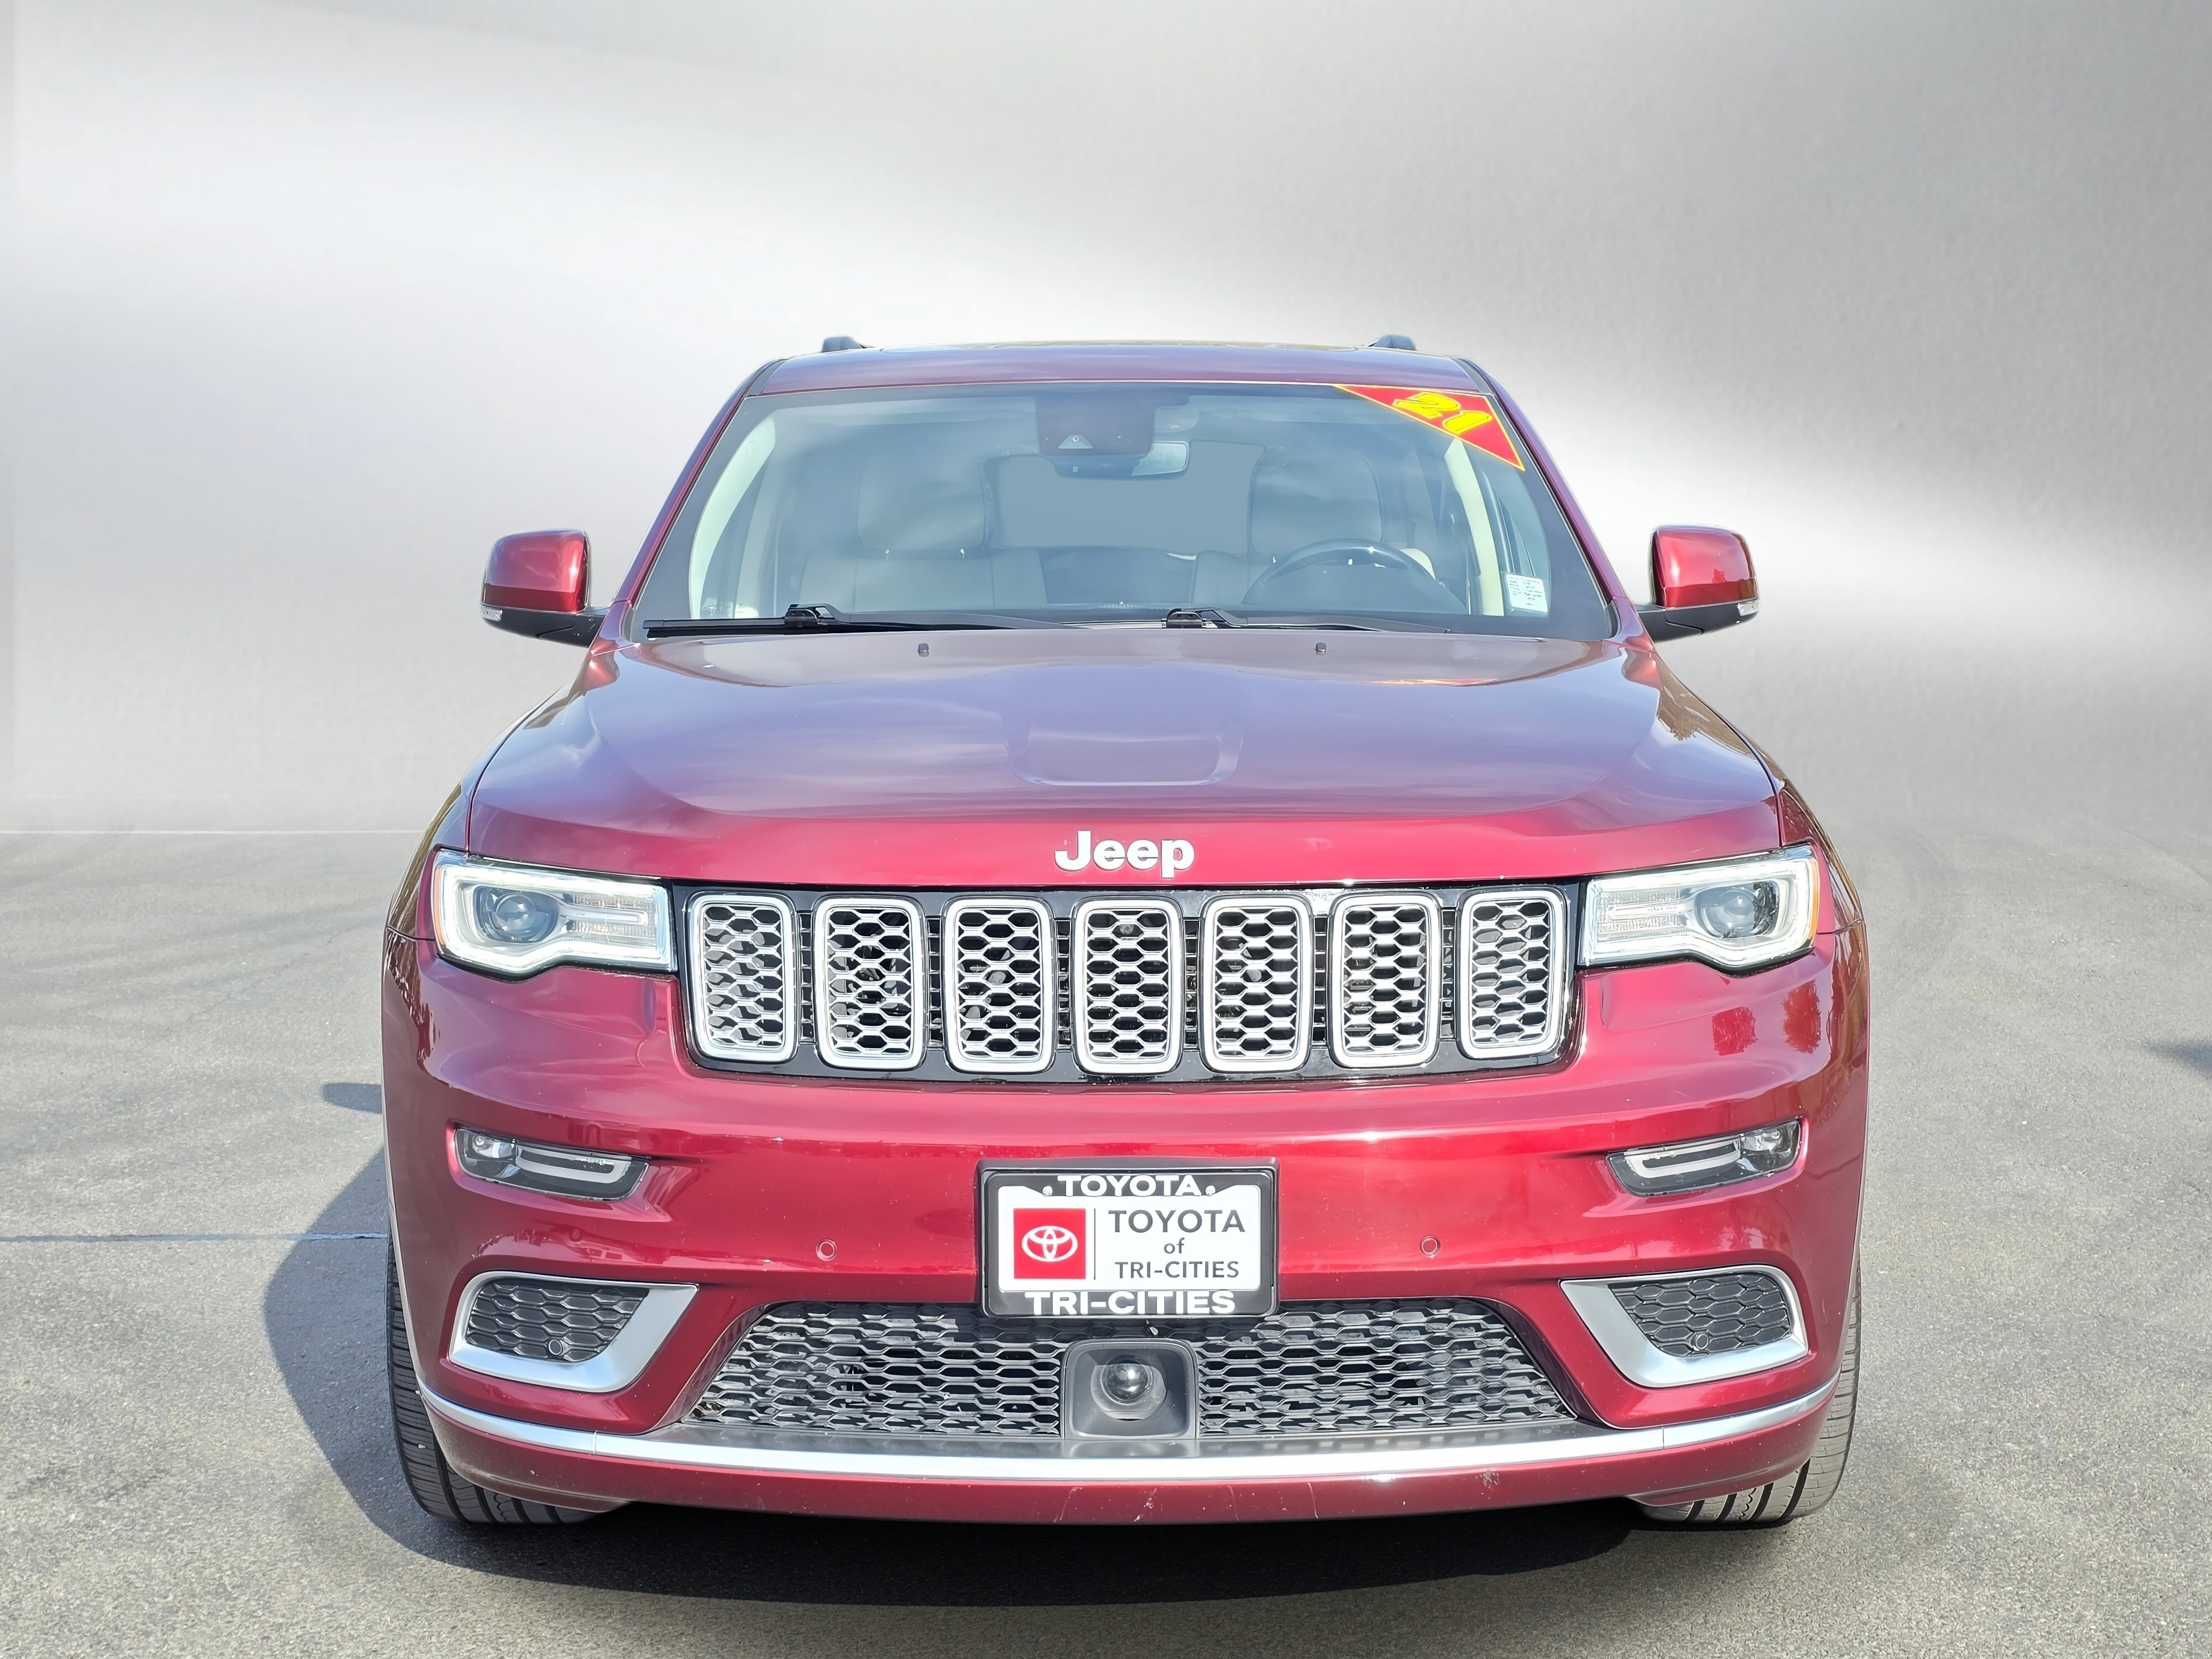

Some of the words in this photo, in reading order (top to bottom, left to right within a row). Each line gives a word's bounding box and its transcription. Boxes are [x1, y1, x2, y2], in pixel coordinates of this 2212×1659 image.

[1392, 391, 1493, 435] 21
[1054, 830, 1194, 879] Jeep
[1057, 1174, 1202, 1197] TOYOTA
[1108, 1209, 1246, 1233] TOYOTA
[1163, 1237, 1185, 1254] of
[1114, 1260, 1239, 1279] TRI-CITIES
[1024, 1290, 1235, 1315] TRI-CITIES
